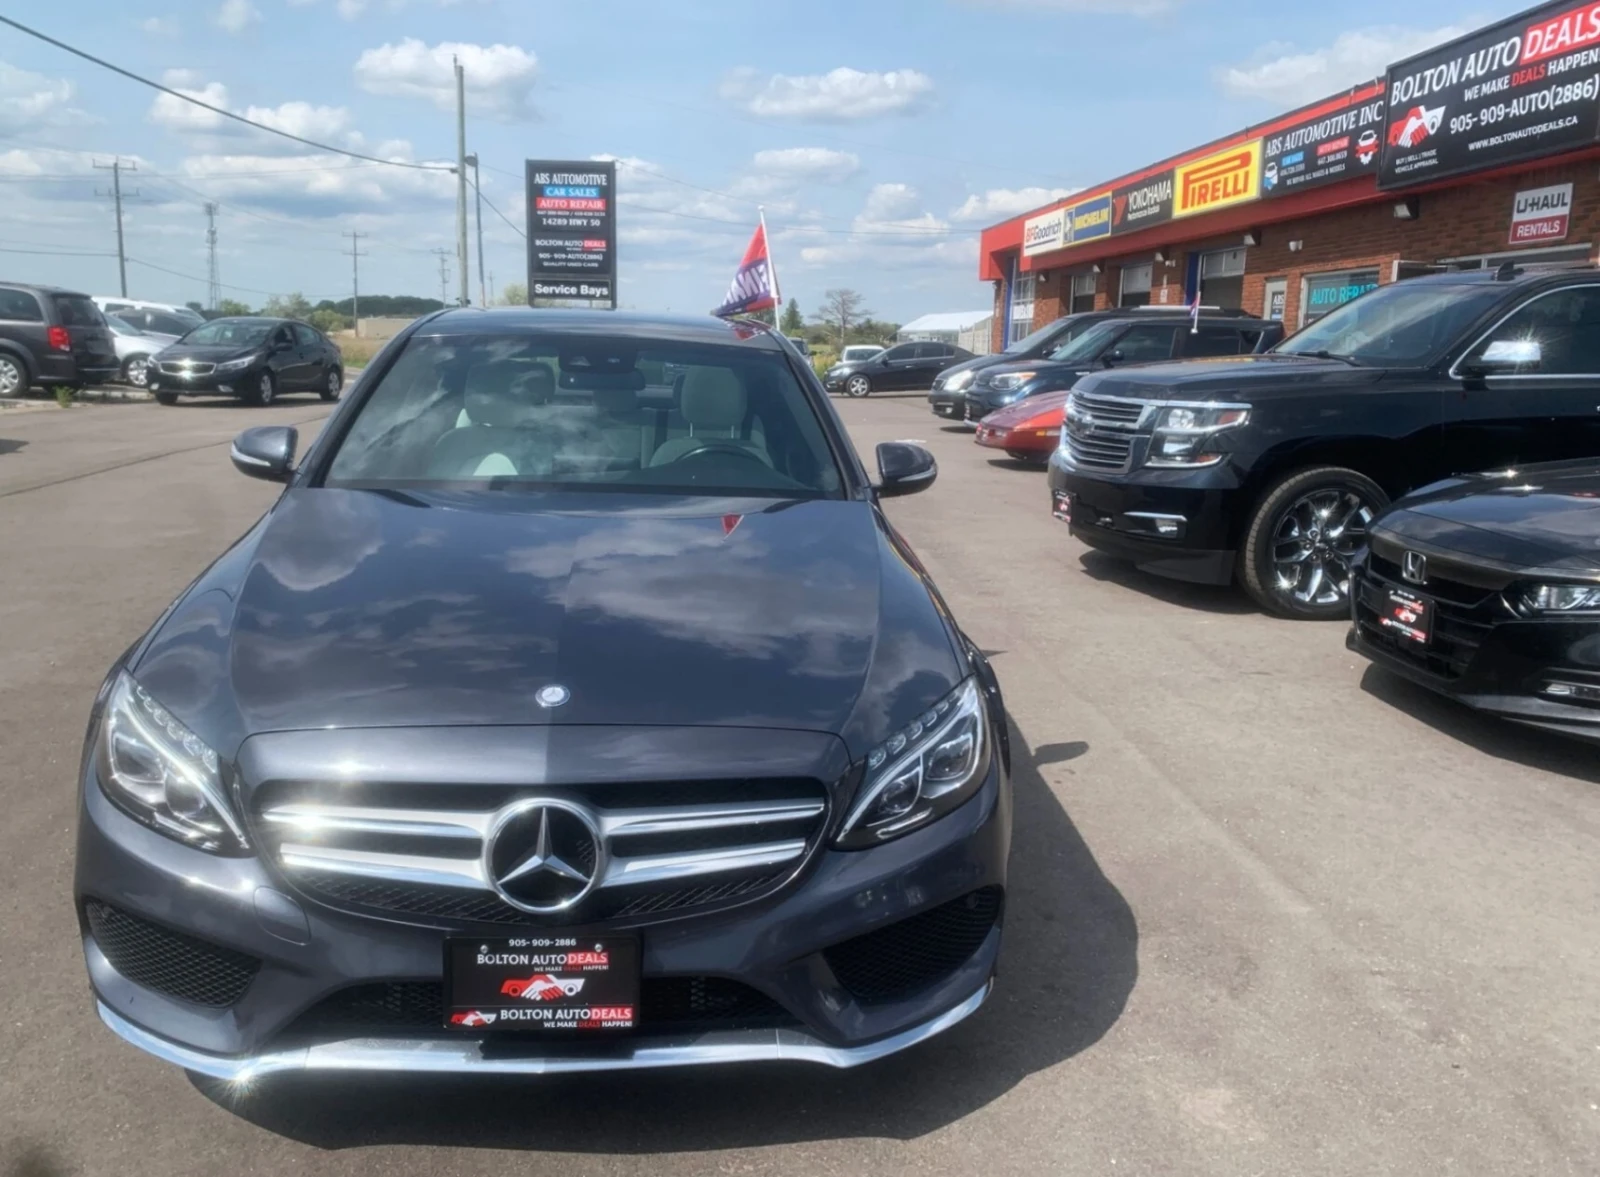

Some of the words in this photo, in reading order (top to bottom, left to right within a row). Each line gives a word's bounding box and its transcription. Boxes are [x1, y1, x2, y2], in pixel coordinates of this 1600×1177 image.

[1390, 57, 1462, 107] BOLTON
[1461, 36, 1521, 81] AUTO
[1523, 6, 1600, 60] DEALS
[1464, 85, 1480, 102] WE
[1481, 75, 1510, 97] MAKE
[1512, 64, 1546, 87] DEALS
[1265, 137, 1282, 158] ABS
[1283, 109, 1358, 152] AUTOMOTIVE
[1359, 100, 1384, 126] INC
[1468, 115, 1578, 151] WWW.BOLTONAUTODEALS.CA
[534, 173, 550, 184] ABS
[551, 173, 608, 185] AUTOMOTIVE
[1181, 150, 1252, 210] PIRELLI
[545, 187, 566, 196] CAR
[568, 187, 597, 197] SALES
[1128, 179, 1172, 212] YOKOHAMA
[540, 199, 566, 208] AUTO
[569, 200, 604, 209] REPAIR
[542, 217, 567, 226] 14289
[569, 218, 588, 226] HWY
[1026, 217, 1062, 242] BFGoodrich
[1516, 220, 1560, 237] RENTALS
[535, 239, 563, 247] BOLTON
[535, 283, 577, 295] Service
[580, 285, 609, 298] Bays
[1311, 287, 1337, 304] AUTO
[477, 953, 529, 965] BOLTON
[500, 1008, 553, 1020] BOLTON
[602, 1020, 633, 1028] HAPPEN!
